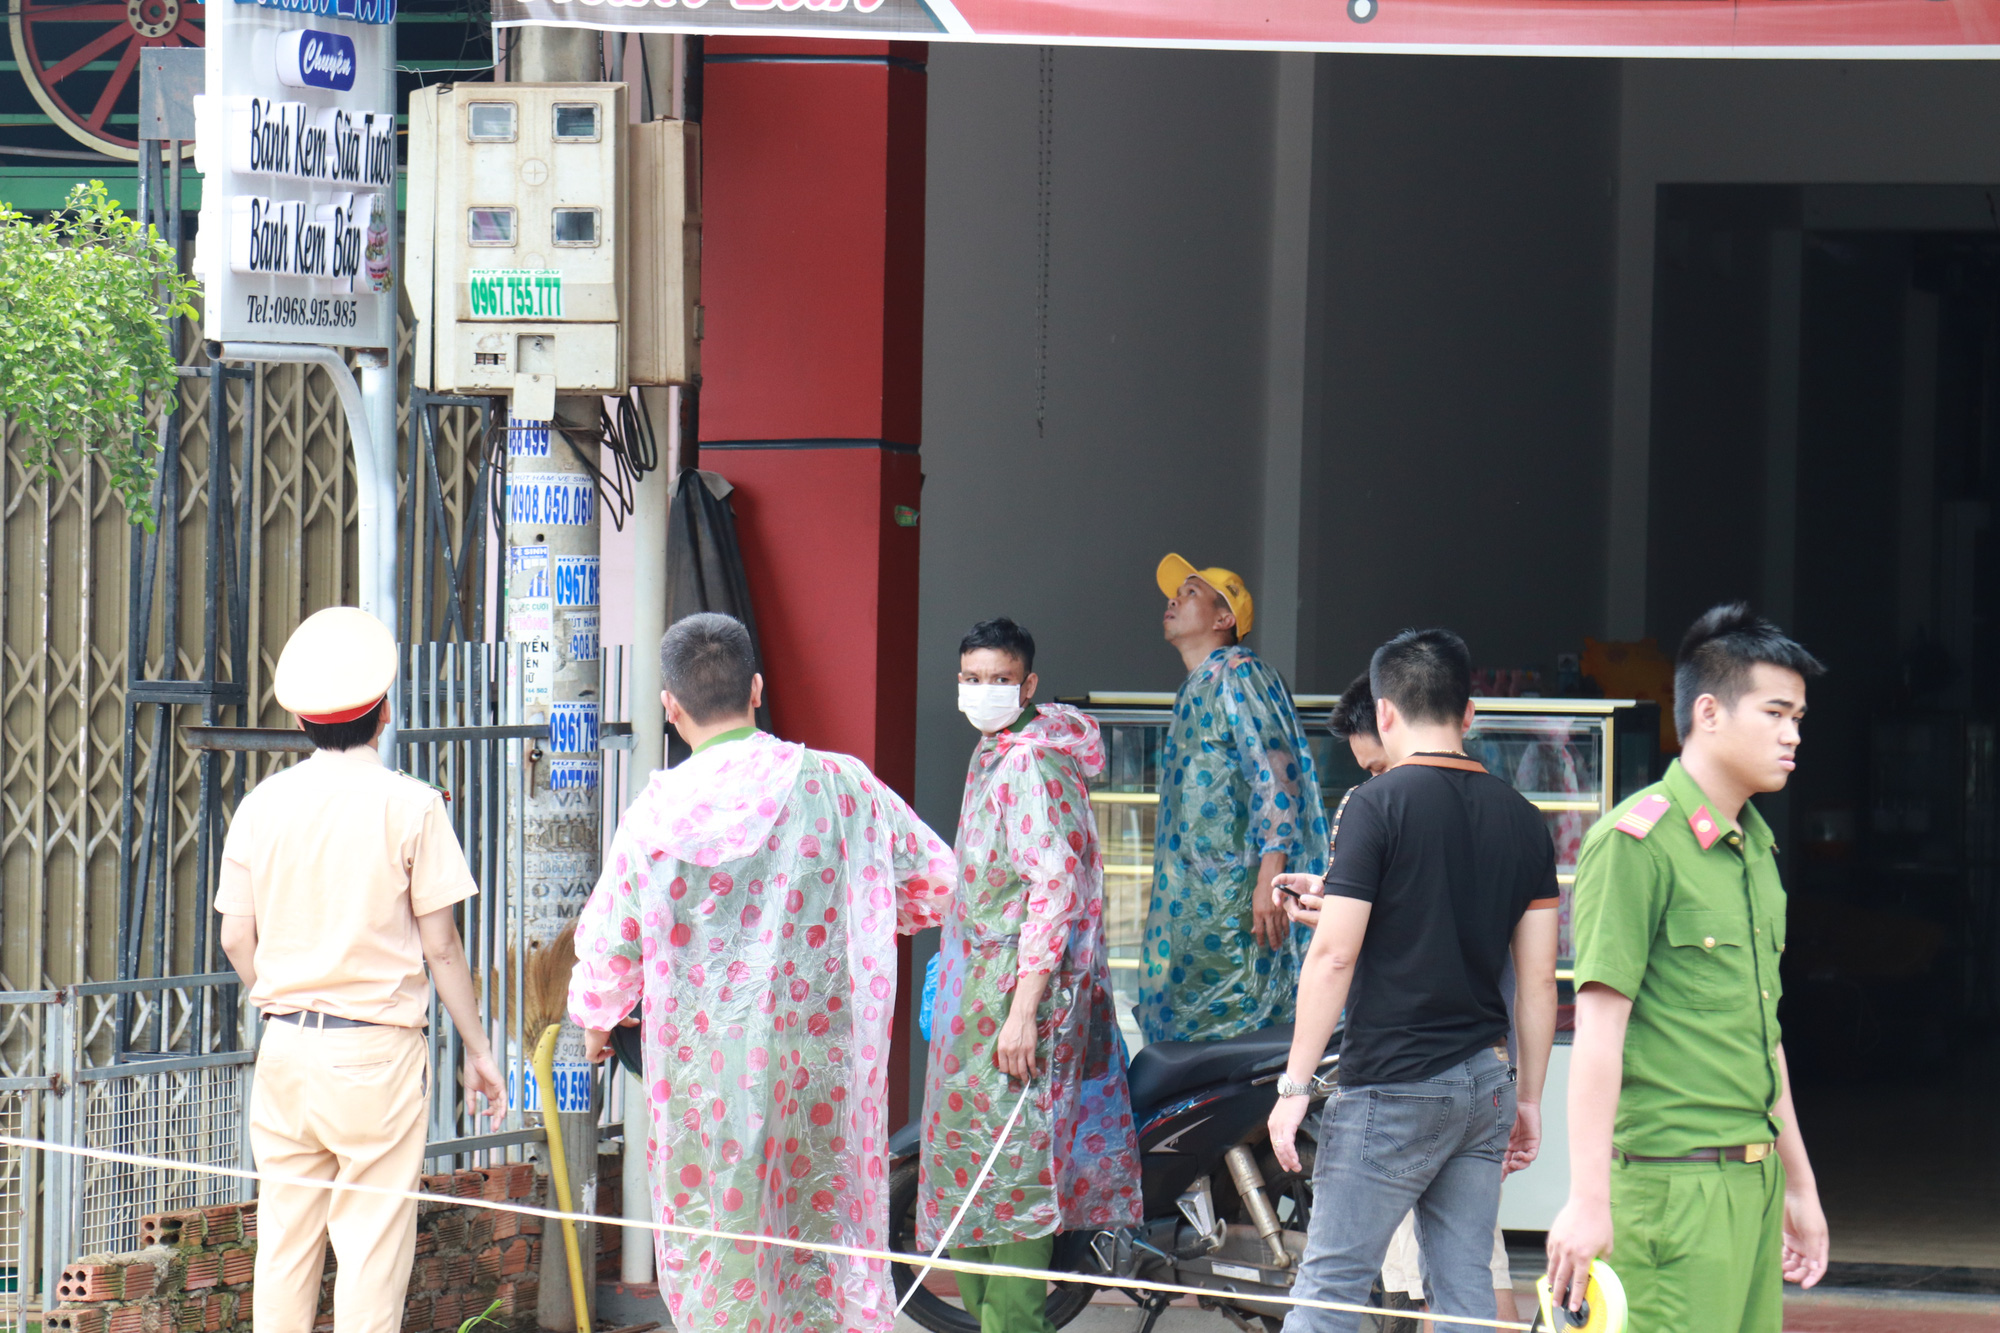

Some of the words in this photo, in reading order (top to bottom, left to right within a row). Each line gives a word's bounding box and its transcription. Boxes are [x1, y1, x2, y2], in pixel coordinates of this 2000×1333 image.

[303, 38, 351, 81] Chuyên
[250, 98, 290, 173] Bánh
[294, 104, 327, 179] Kem
[332, 109, 360, 182] Sữa
[249, 198, 289, 273] Bánh
[294, 203, 326, 276] Kem
[333, 193, 361, 293] Bắp
[247, 295, 357, 327] Tel:0968.915.985
[471, 277, 561, 316] 0967.755.777
[512, 484, 594, 526] 0908.050.060
